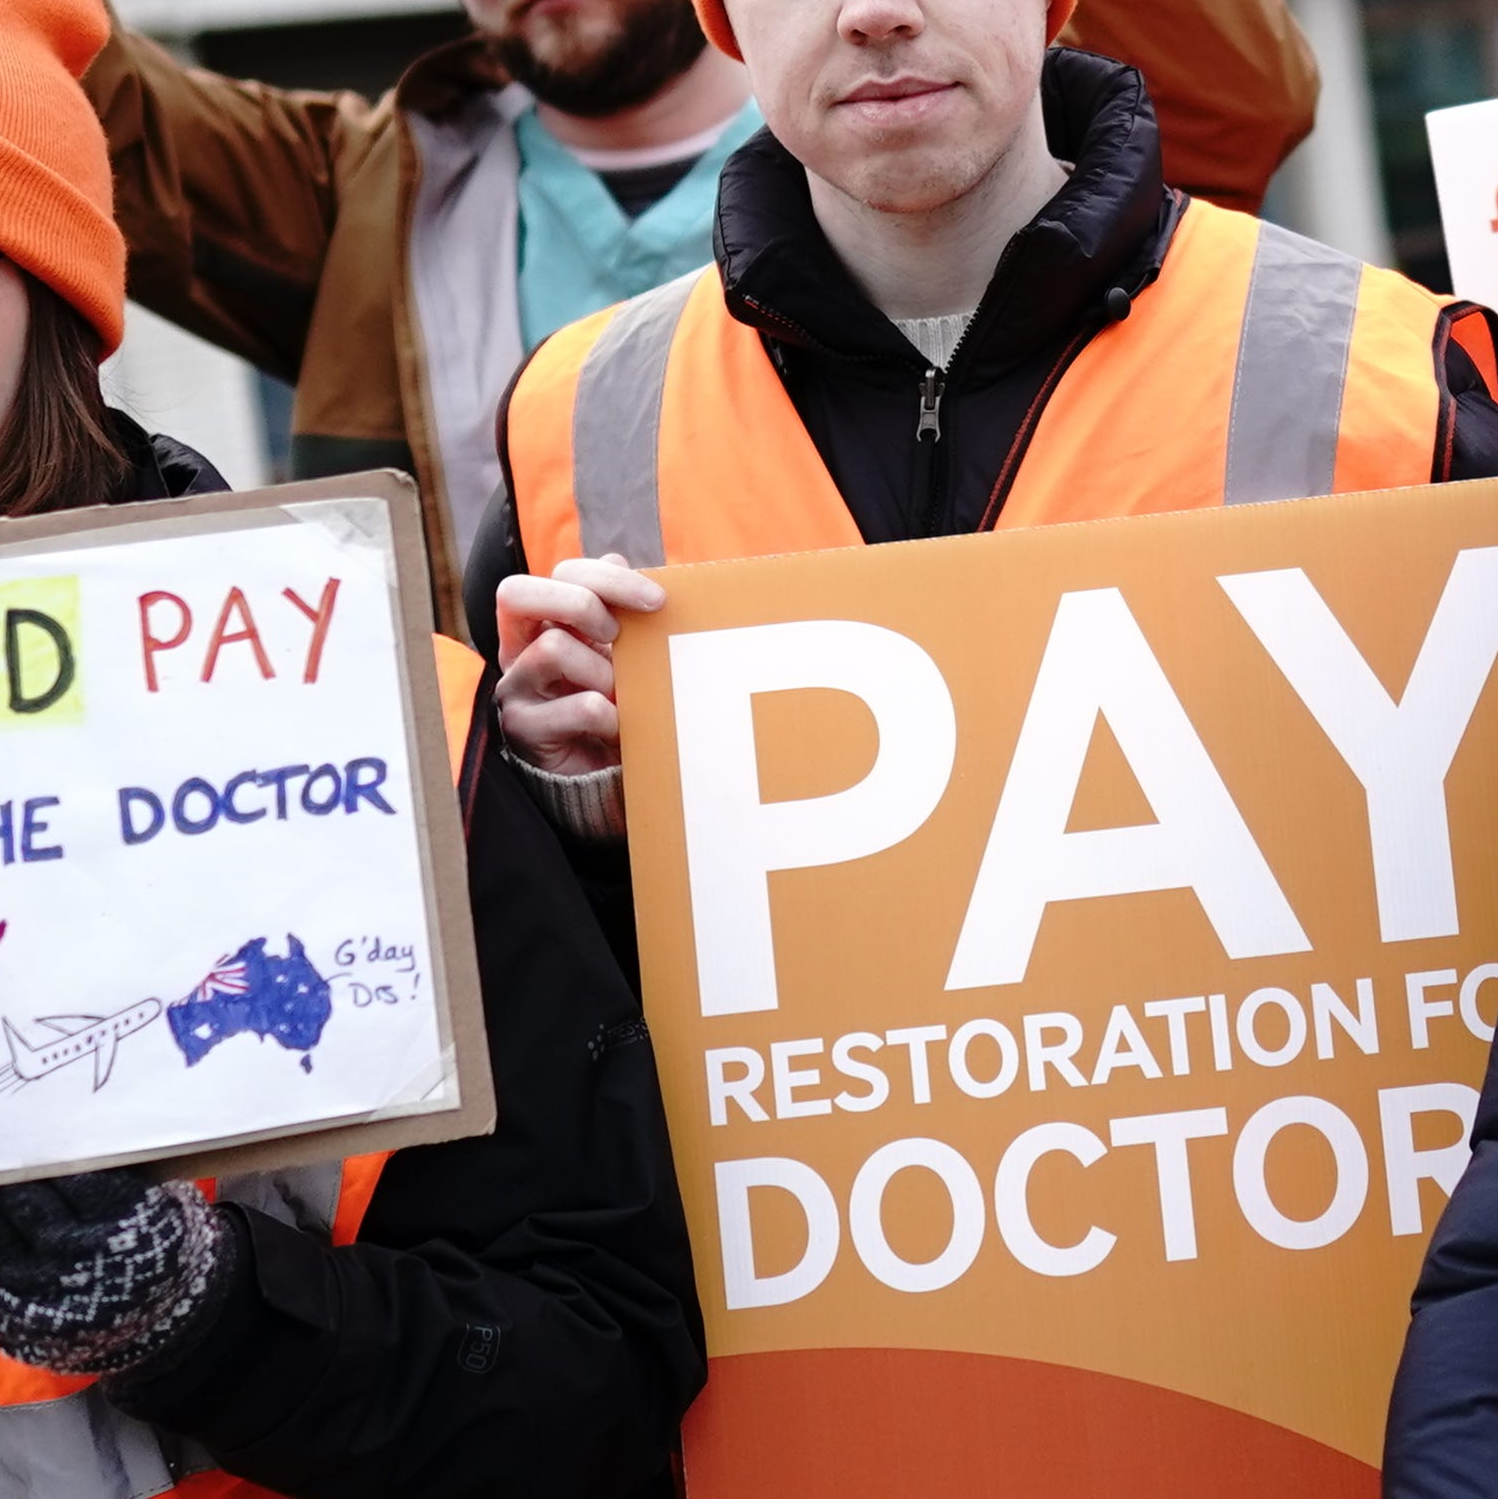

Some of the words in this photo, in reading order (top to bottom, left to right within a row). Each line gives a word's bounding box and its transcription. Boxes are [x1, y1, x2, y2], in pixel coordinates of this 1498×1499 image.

[137, 576, 341, 693] PAY
[118, 756, 398, 845] DOCTOR
[334, 935, 416, 973] G'day
[704, 976, 1381, 1127] RESTORATION
[712, 1080, 1482, 1312] DOCTOR
[465, 1324, 494, 1370] P50
